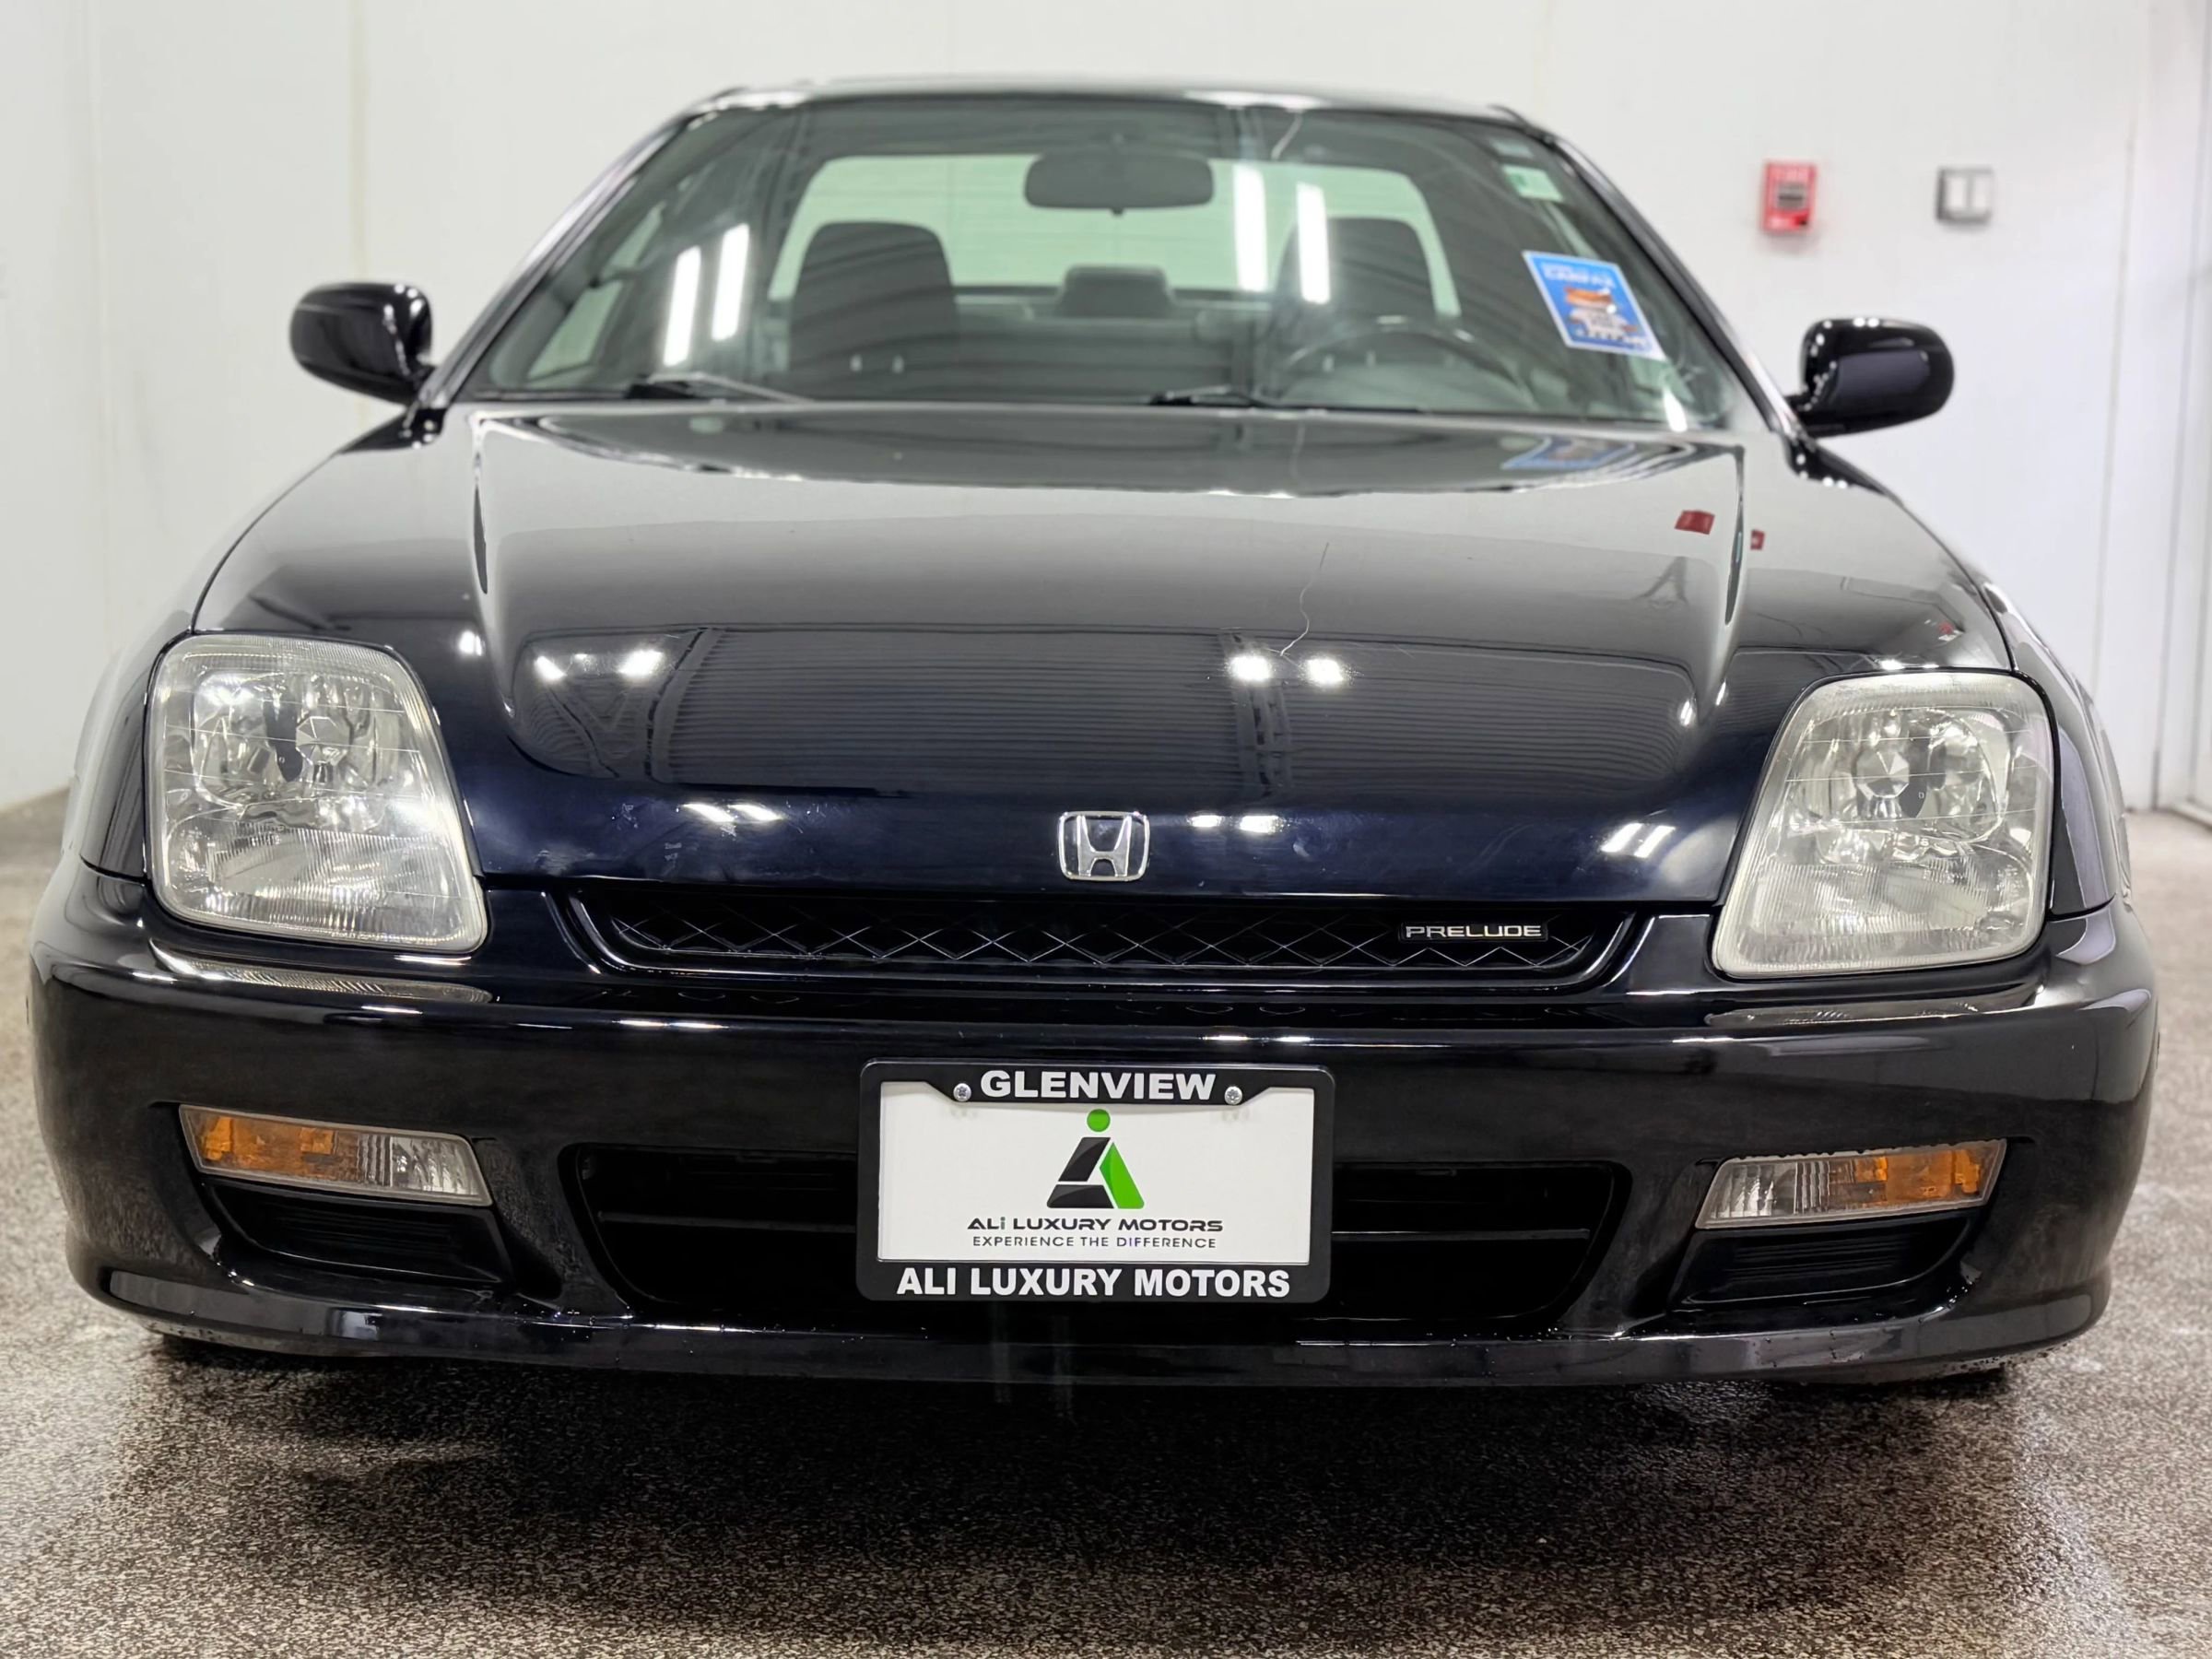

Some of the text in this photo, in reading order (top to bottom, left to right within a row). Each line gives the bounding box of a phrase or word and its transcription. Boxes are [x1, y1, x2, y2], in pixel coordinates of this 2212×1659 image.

[1406, 925, 1542, 937] PRELUDE
[980, 1070, 1216, 1100] GLENVIEW
[1013, 1218, 1112, 1230] LUXURY
[1118, 1218, 1223, 1232] MOTORS
[972, 1236, 1217, 1249] EXPERIENCE THE DIFFERENCE
[897, 1267, 1289, 1298] ALI LUXURY MOTORS
